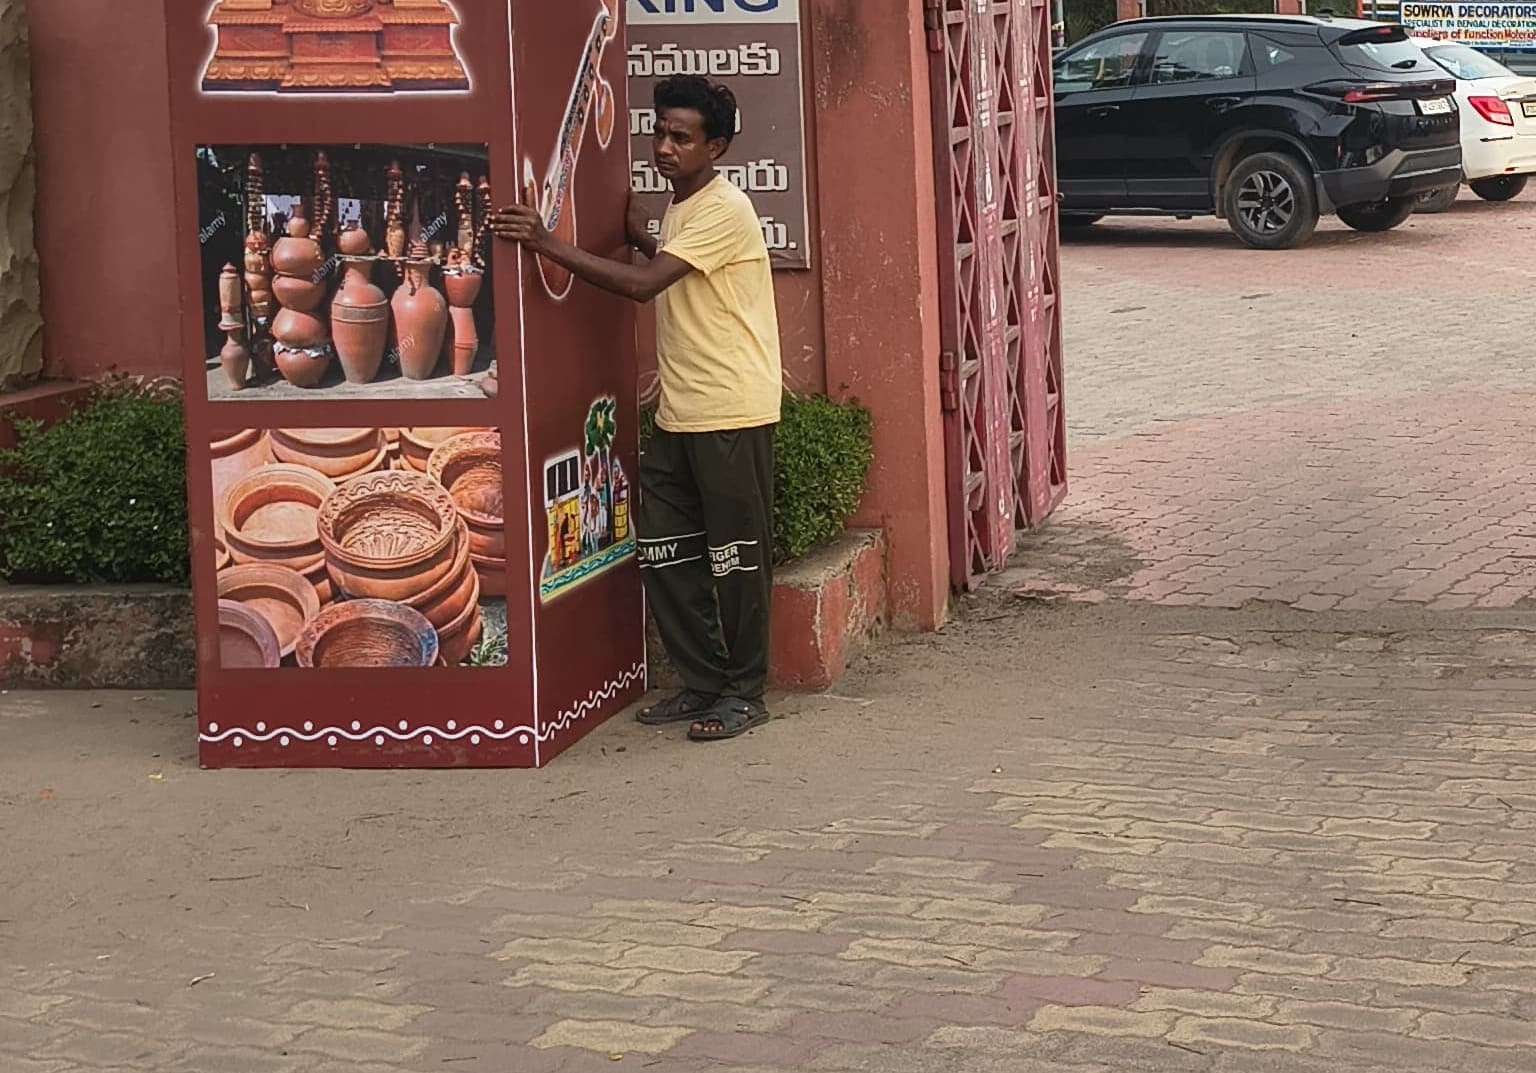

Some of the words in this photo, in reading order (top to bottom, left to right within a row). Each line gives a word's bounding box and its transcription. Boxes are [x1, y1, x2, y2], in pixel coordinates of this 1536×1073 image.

[1404, 4, 1454, 18] SOWRYA
[1411, 29, 1448, 39] uppliers
[1451, 29, 1462, 39] of
[199, 211, 226, 244] alamy
[420, 211, 448, 242] alamy
